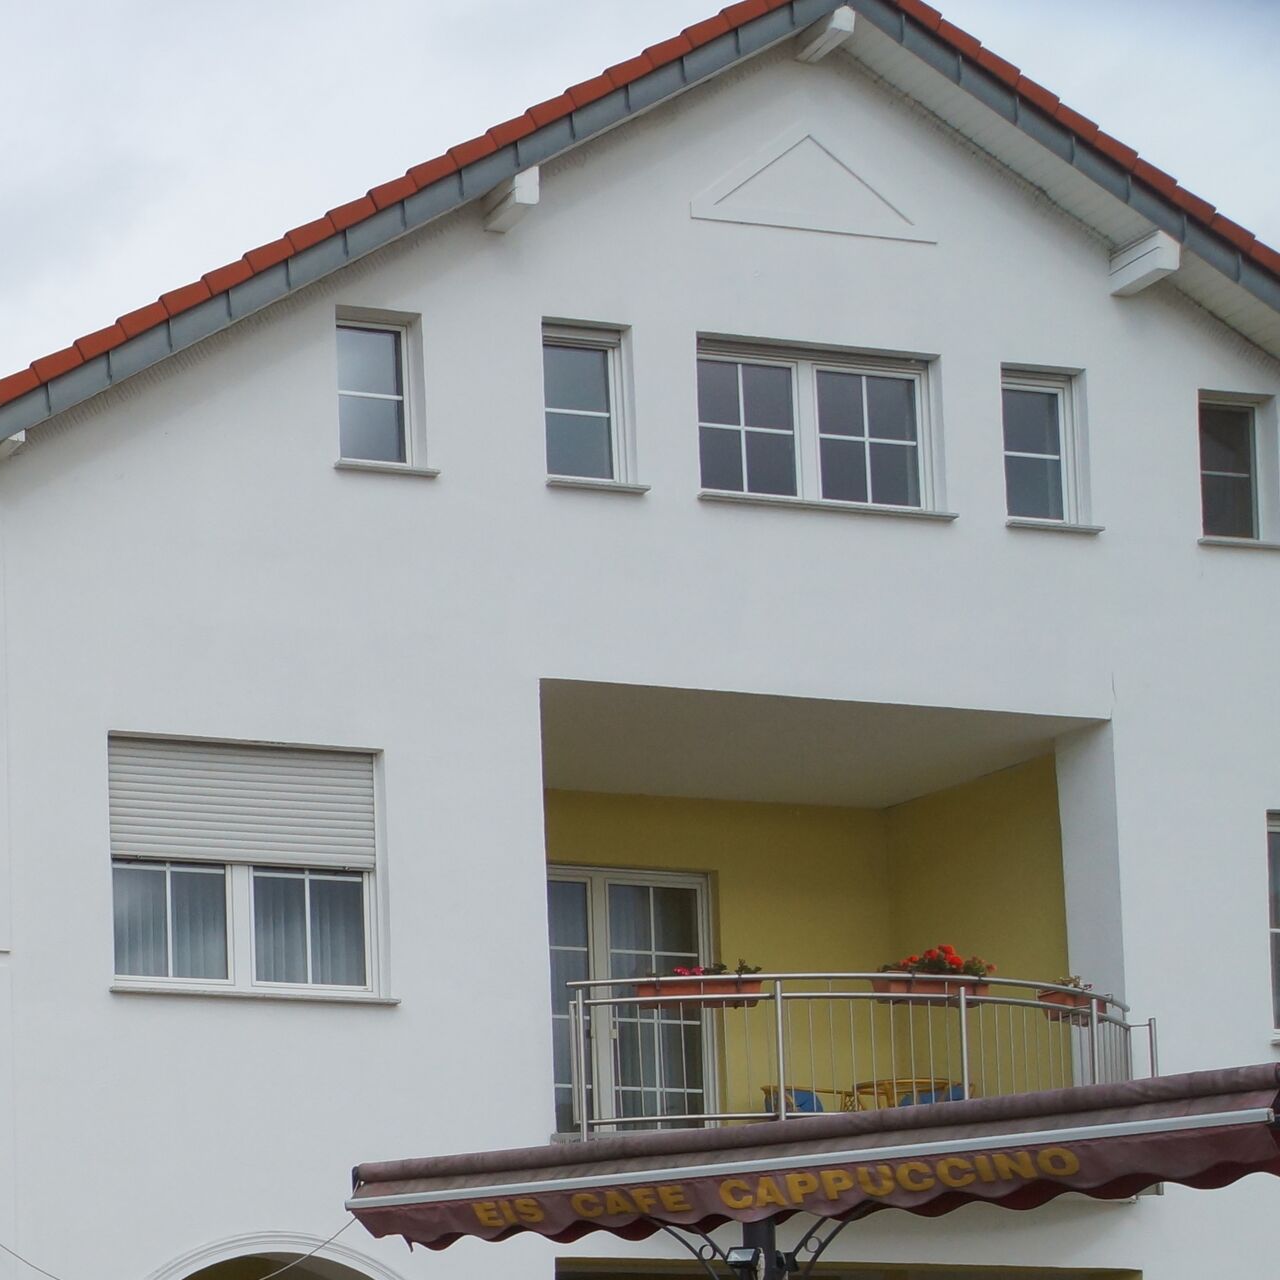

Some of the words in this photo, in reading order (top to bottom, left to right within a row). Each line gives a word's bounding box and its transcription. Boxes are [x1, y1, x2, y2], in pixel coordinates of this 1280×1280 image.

[473, 1198, 545, 1228] EIS
[571, 1185, 690, 1219] CAFE
[719, 1146, 1081, 1210] CAPPUCCINO
